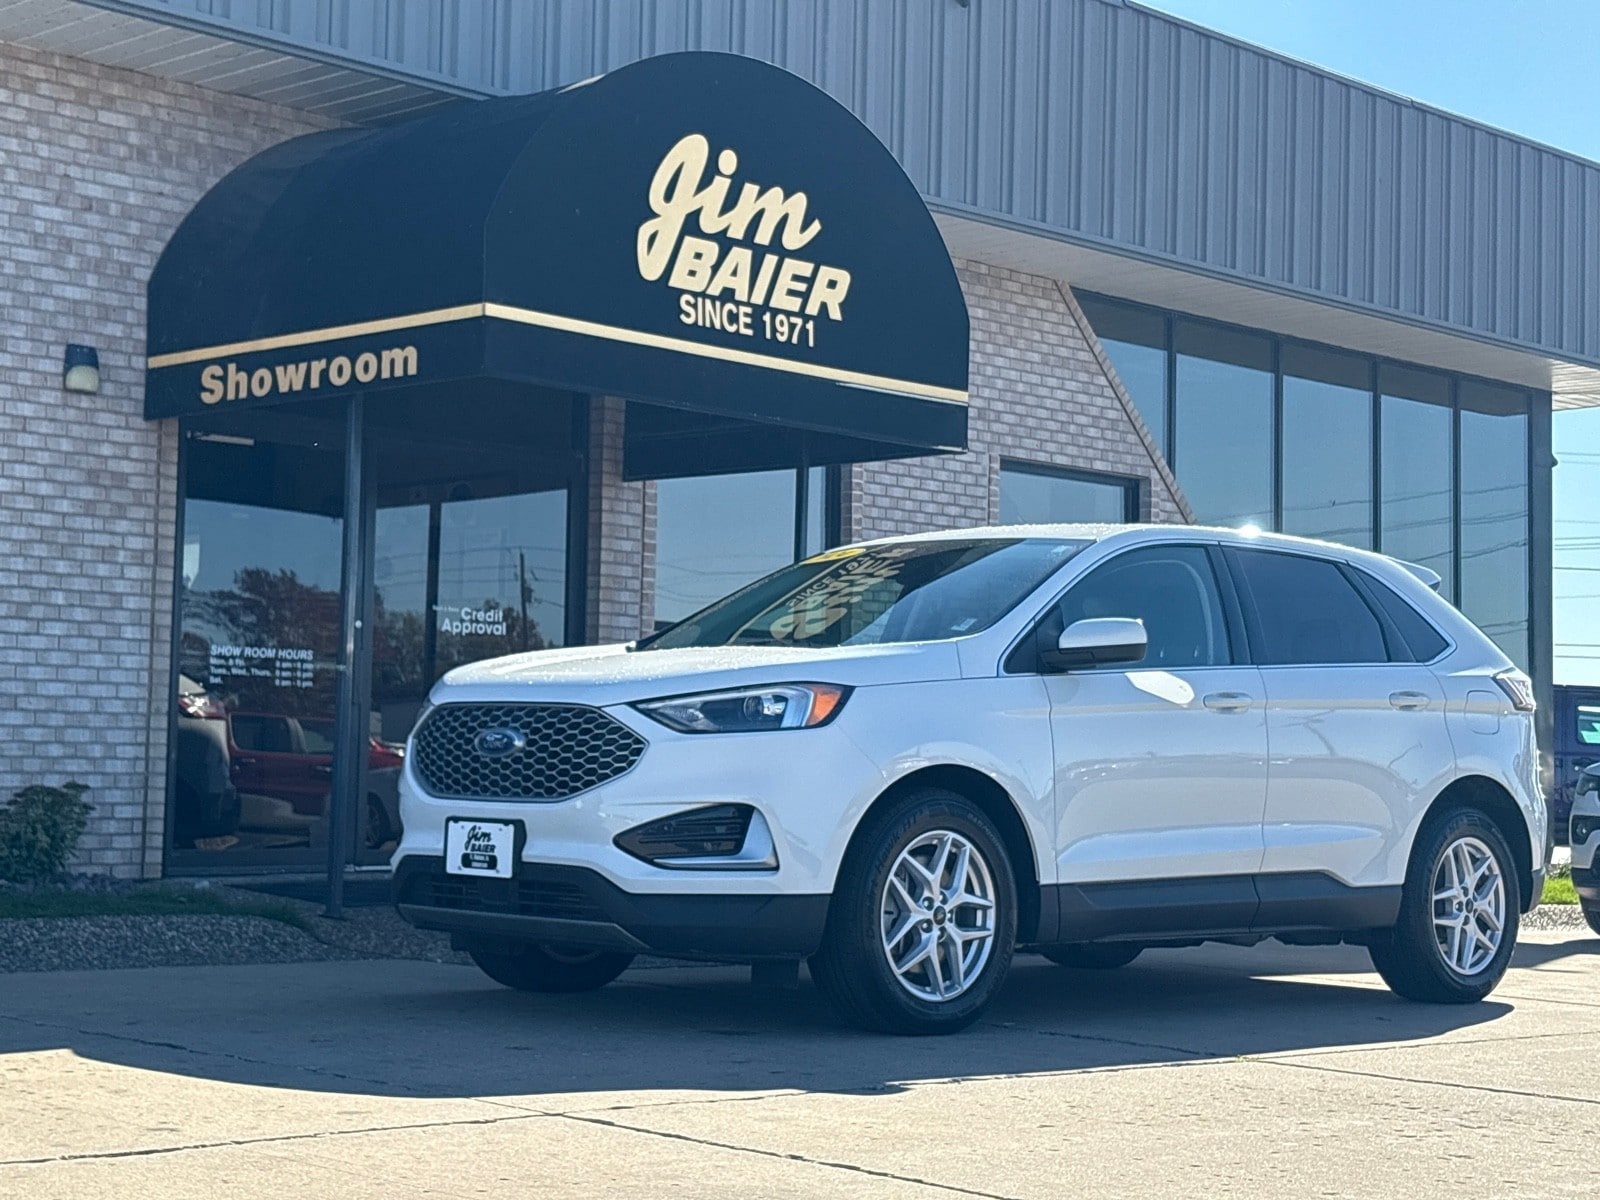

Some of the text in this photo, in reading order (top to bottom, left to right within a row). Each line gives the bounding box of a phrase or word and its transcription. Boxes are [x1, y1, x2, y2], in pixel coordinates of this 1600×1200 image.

[637, 134, 822, 281] Jim
[668, 235, 851, 321] BAIER
[679, 294, 815, 347] SINCE 1971
[200, 345, 418, 405] Showroom
[441, 617, 507, 636] Approval
[461, 606, 503, 622] Credit
[210, 644, 314, 661] SHOW ROOM HOURS
[464, 825, 492, 851] Jim
